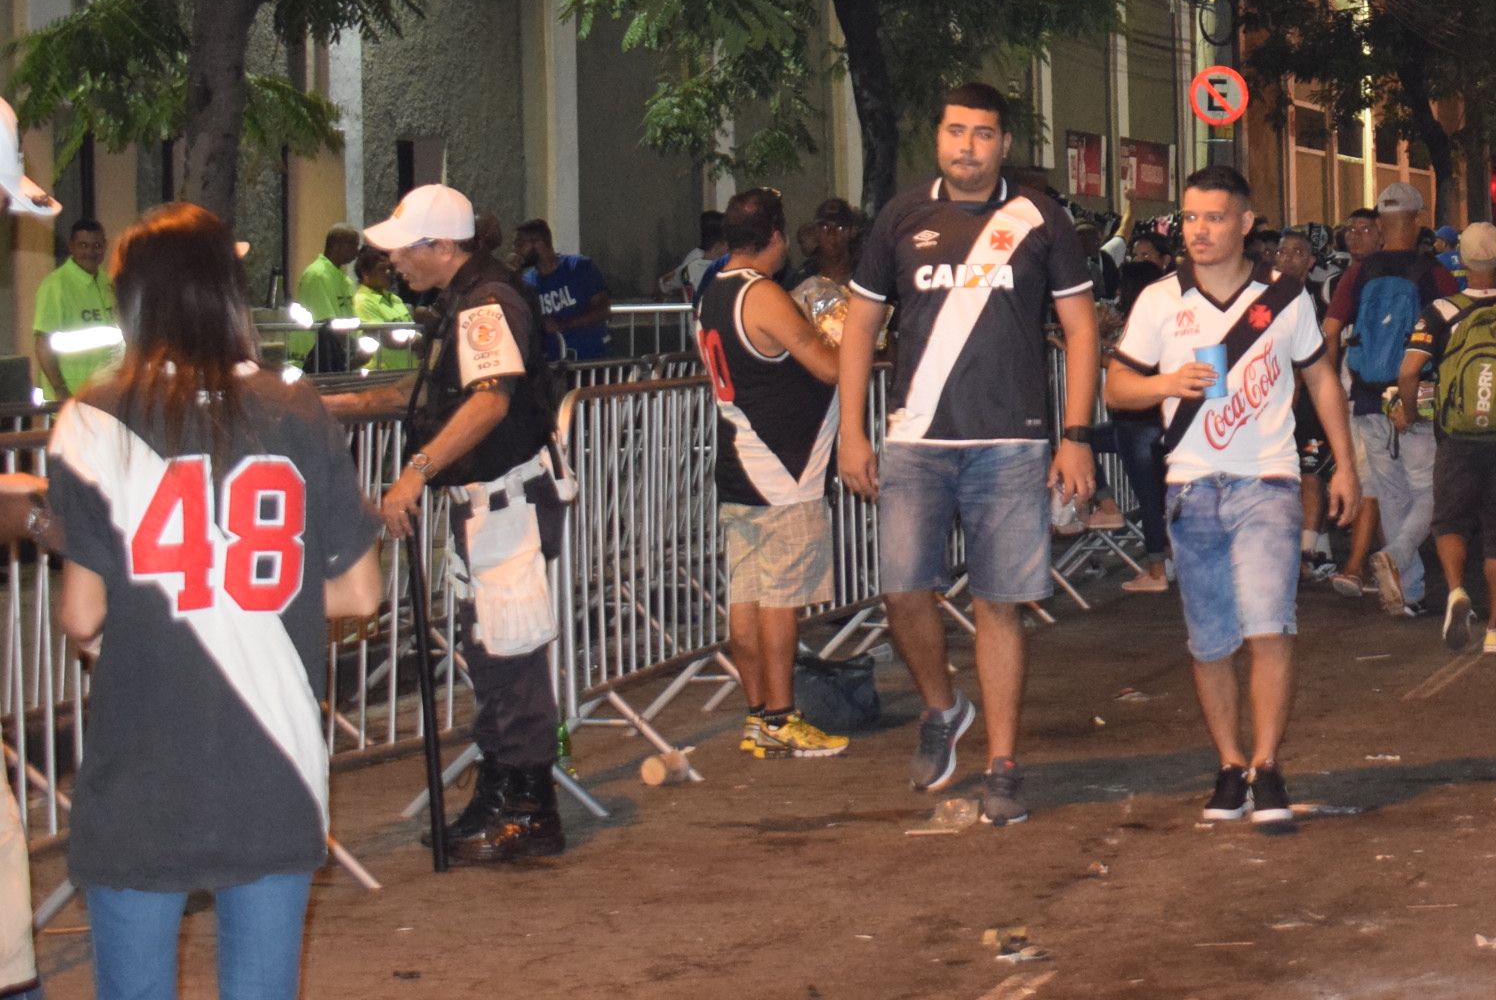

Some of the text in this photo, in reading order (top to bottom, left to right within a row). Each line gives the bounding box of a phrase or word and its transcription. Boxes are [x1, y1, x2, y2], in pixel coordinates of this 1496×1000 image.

[914, 263, 1014, 290] CAIXA
[539, 285, 577, 314] ISCAL
[129, 454, 306, 618] 48
